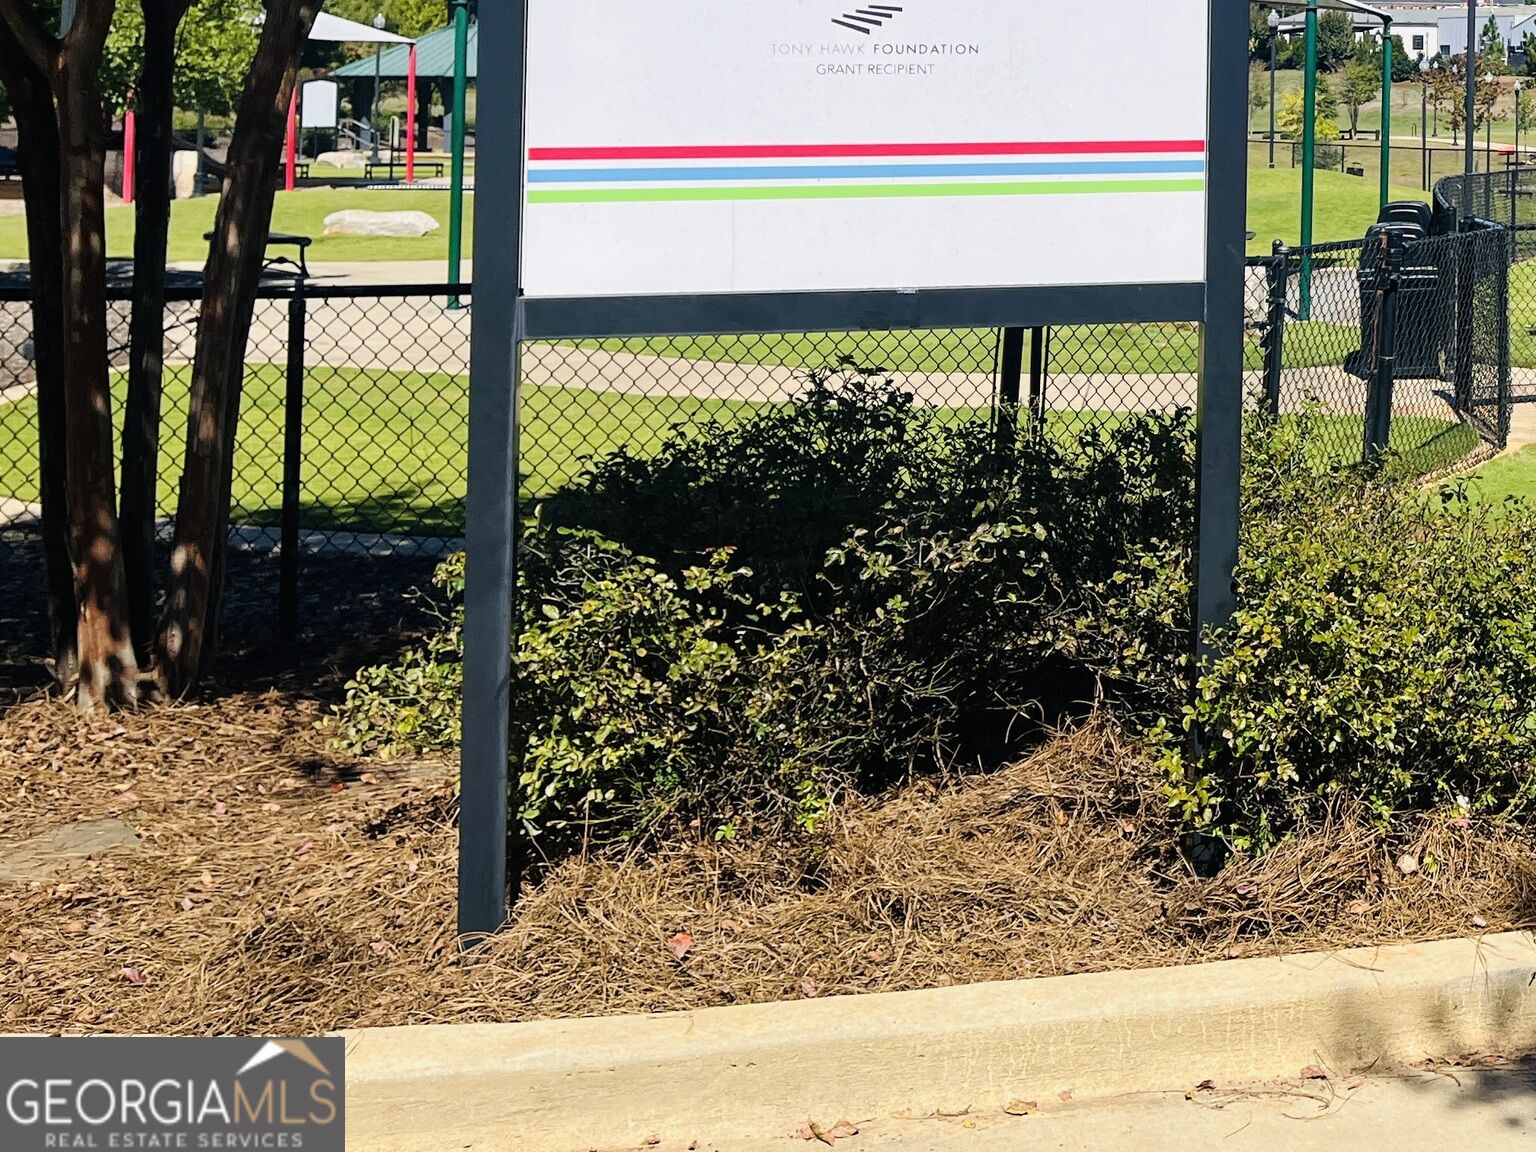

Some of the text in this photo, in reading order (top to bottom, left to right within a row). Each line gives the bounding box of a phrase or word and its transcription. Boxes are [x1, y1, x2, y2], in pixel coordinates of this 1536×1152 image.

[769, 40, 980, 57] TONY HAWK FOUNDATION
[815, 63, 936, 76] GRANT RECIPIENT
